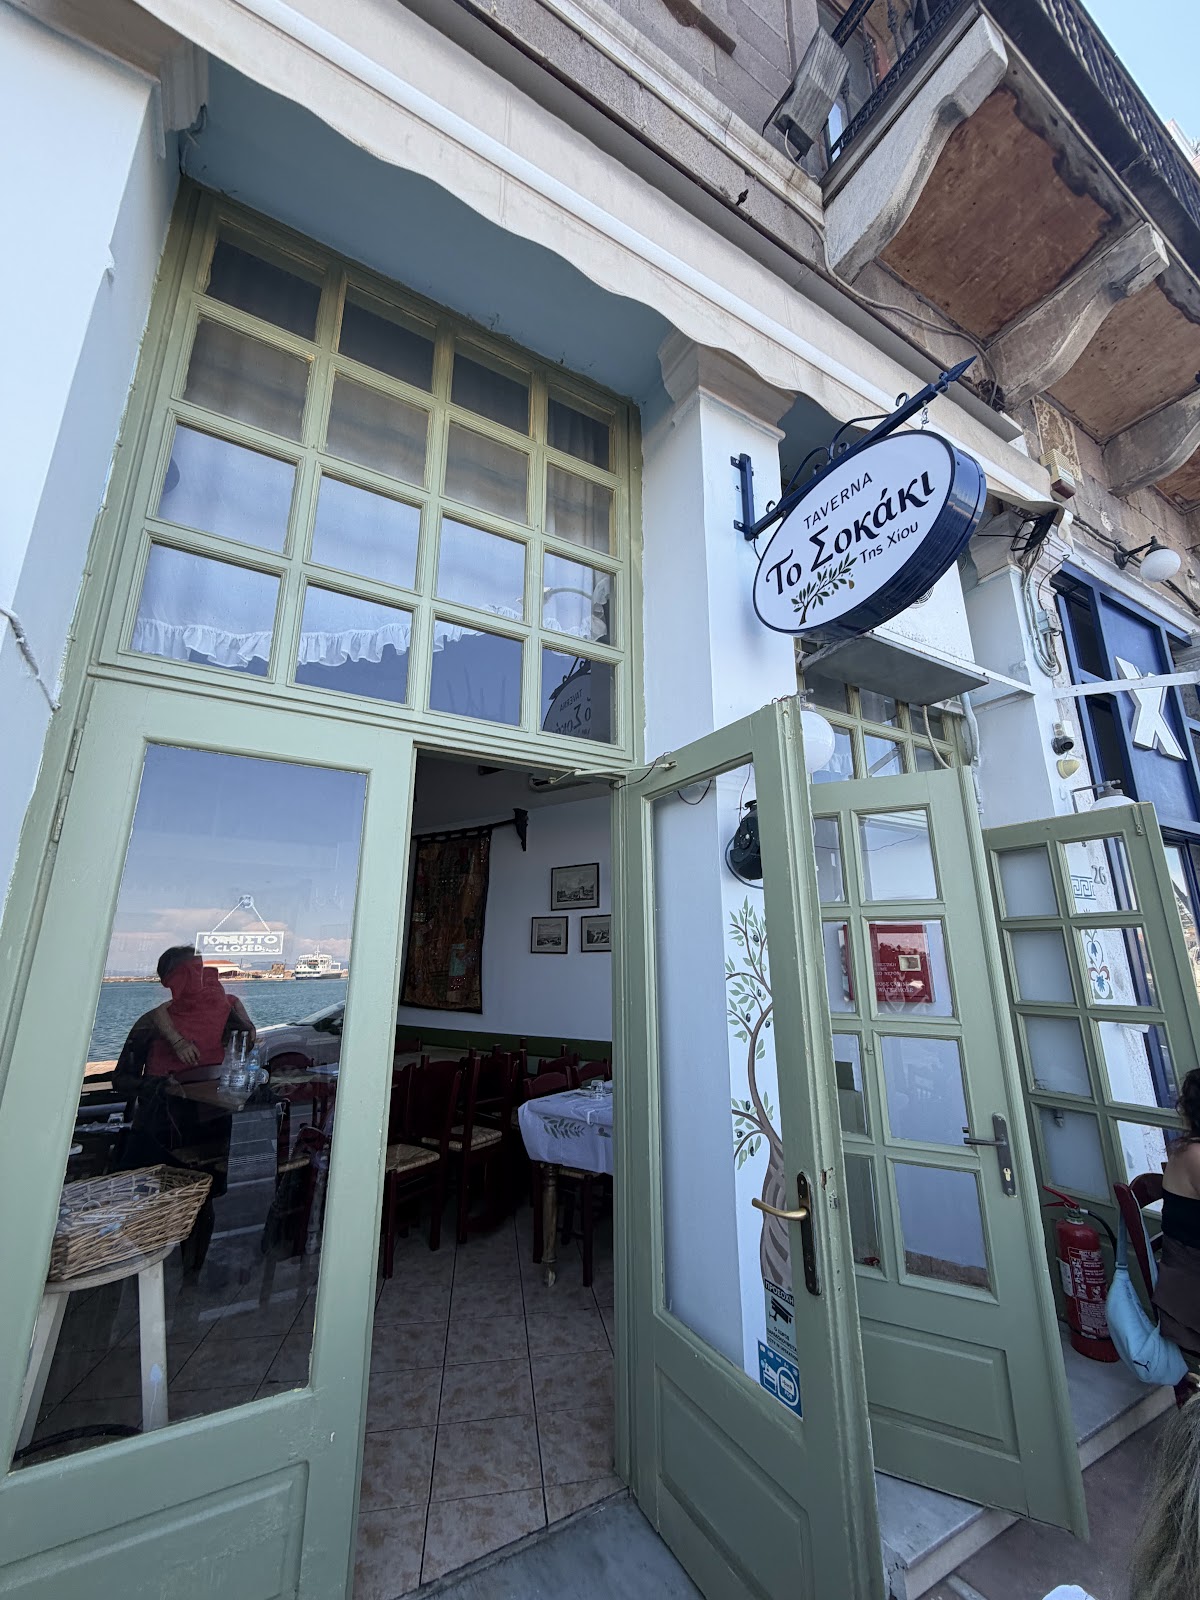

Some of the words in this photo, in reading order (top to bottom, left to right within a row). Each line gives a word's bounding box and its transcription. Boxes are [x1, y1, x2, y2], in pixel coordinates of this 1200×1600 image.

[803, 472, 873, 530] TAVERNA
[766, 549, 802, 595] Το
[809, 471, 936, 572] Σοκάκι
[886, 521, 919, 549] Χίου
[1091, 864, 1107, 886] 26
[214, 944, 262, 953] CLOSED
[765, 1280, 794, 1305] ΠΡΟΣΟΧΗ
